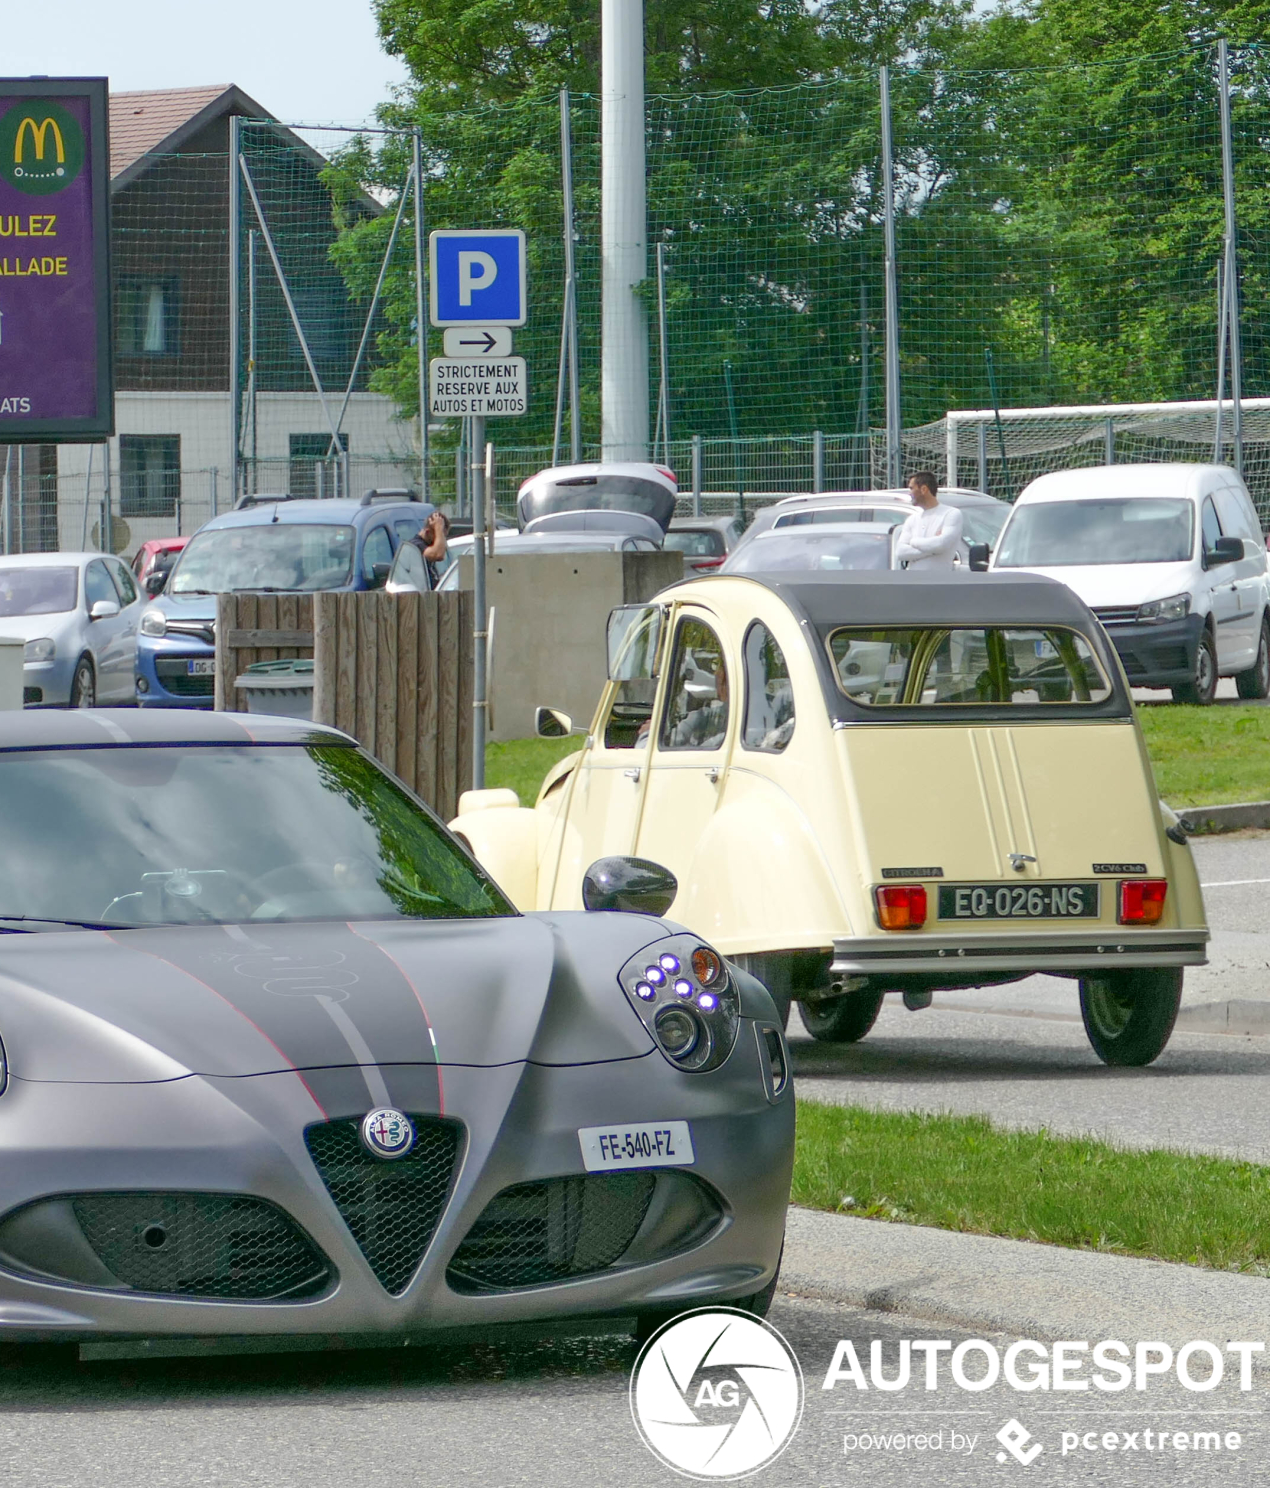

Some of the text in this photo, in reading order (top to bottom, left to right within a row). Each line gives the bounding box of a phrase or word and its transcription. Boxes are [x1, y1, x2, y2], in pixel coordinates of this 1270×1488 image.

[458, 251, 498, 306] P
[437, 365, 518, 378] STRICTEMENT
[437, 381, 519, 395] RESERVE AUX
[433, 399, 524, 412] AUTOS ET MOTOS
[955, 887, 1084, 916] EQ-026-NS
[599, 1130, 675, 1161] FE-540-FZ
